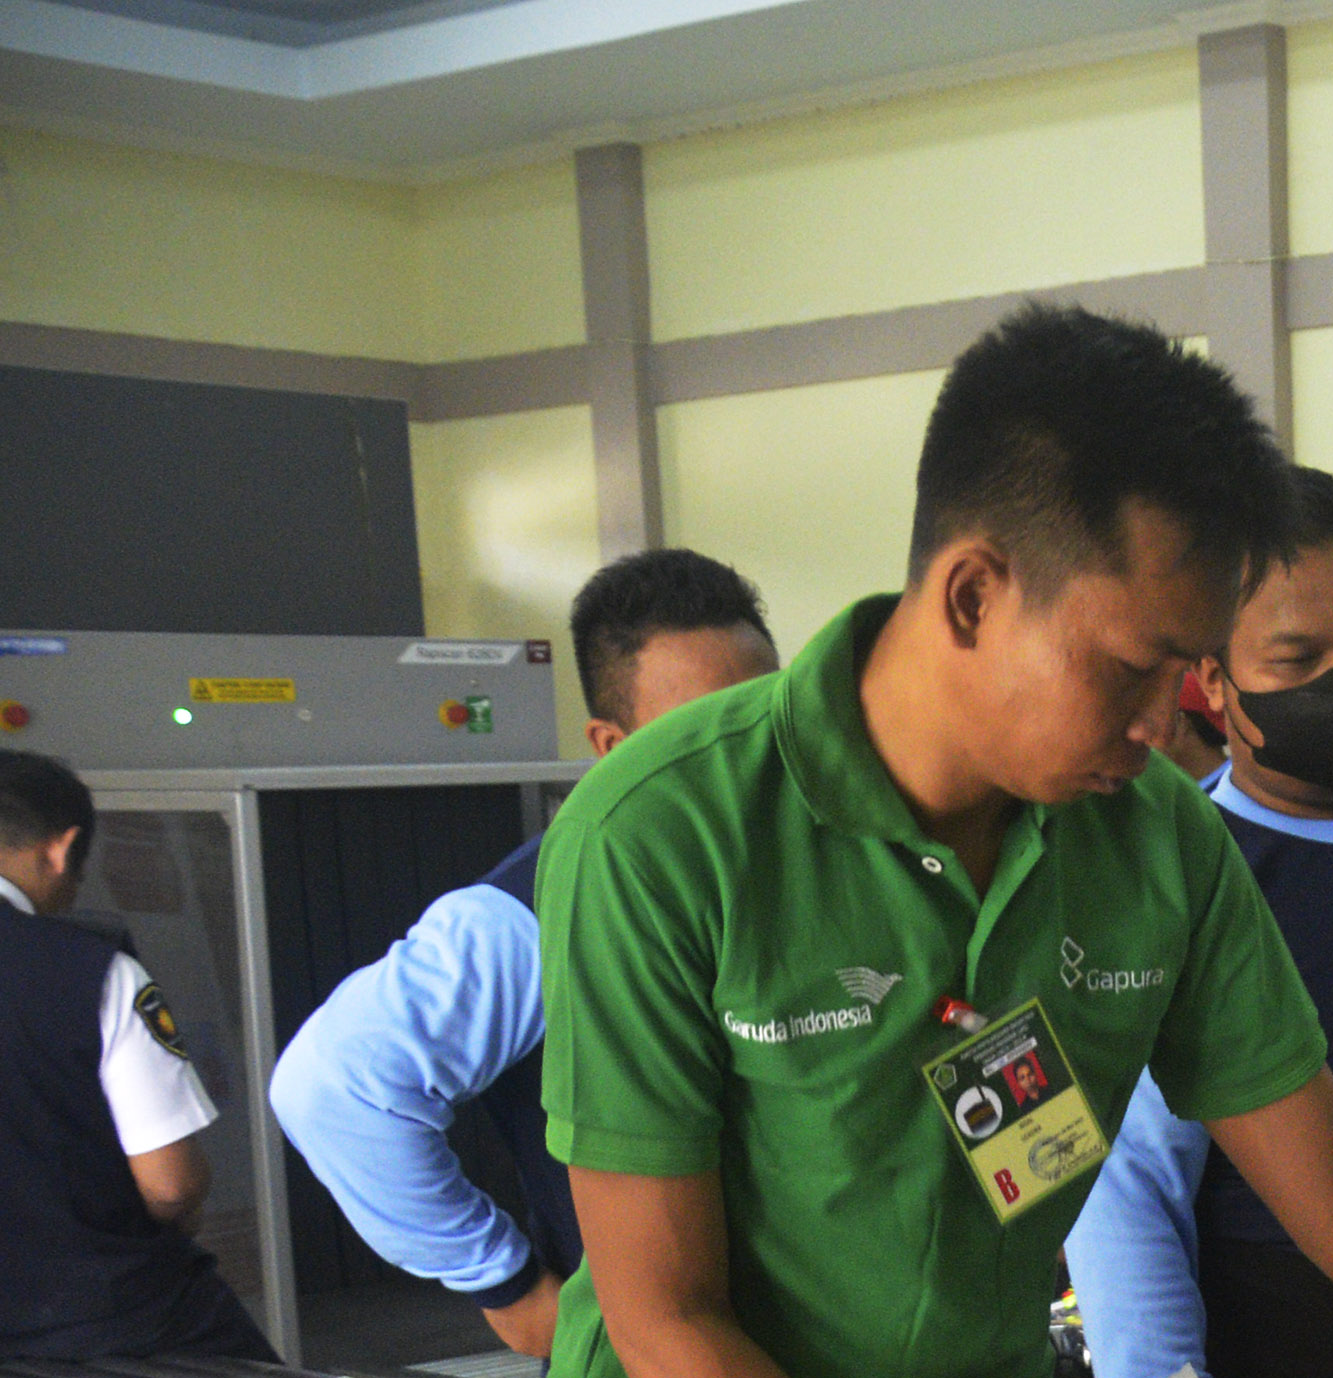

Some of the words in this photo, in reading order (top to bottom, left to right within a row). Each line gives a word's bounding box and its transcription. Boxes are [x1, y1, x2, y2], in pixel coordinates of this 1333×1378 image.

[1086, 967, 1165, 995] Gapura
[724, 1010, 787, 1043] Garuda
[789, 1003, 872, 1038] Indonesia
[993, 1167, 1021, 1205] B
